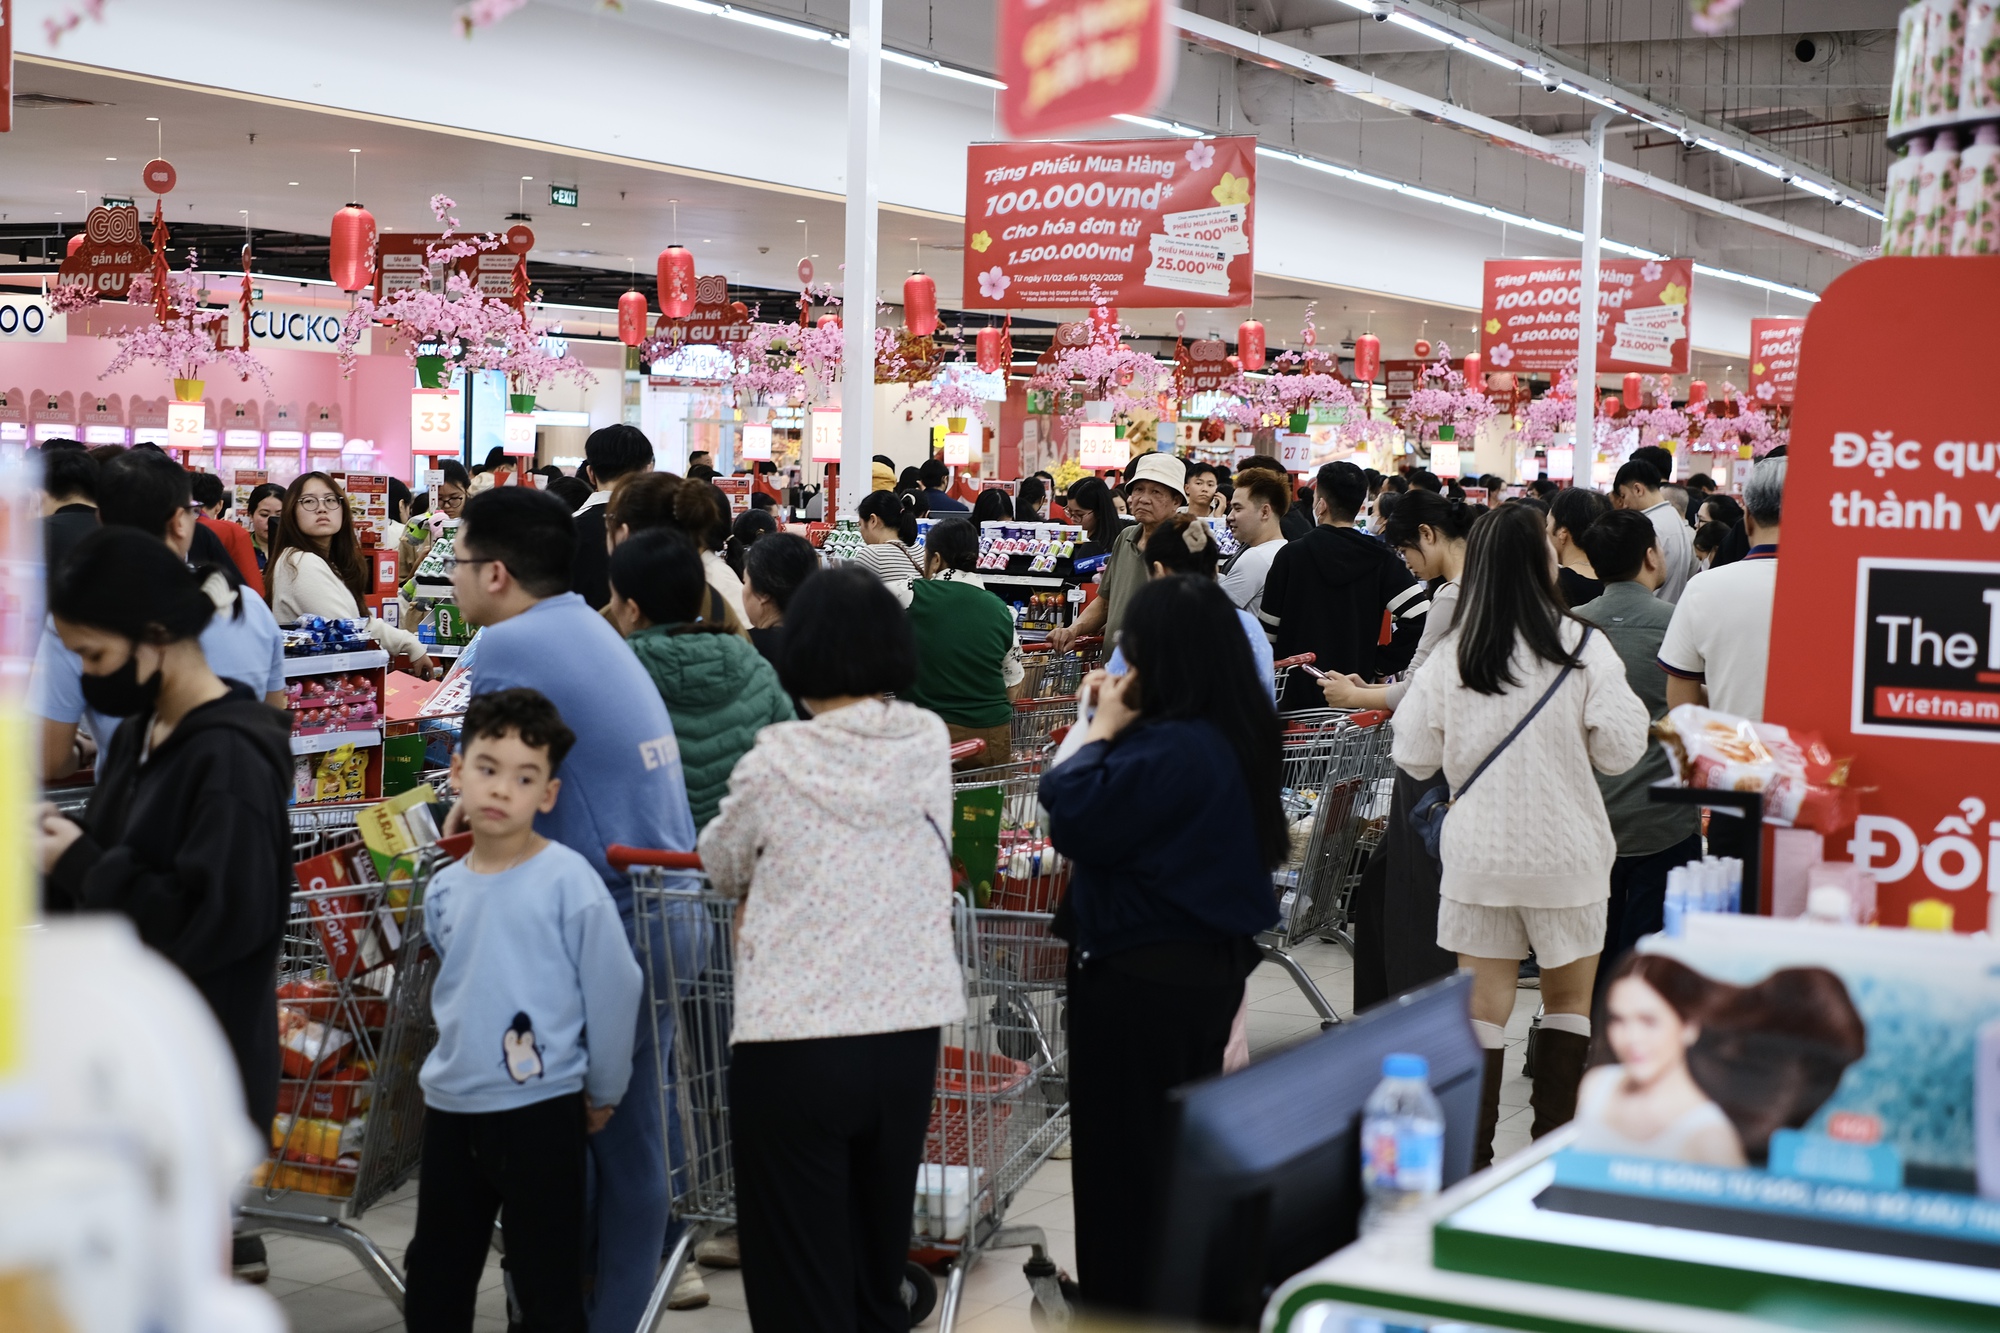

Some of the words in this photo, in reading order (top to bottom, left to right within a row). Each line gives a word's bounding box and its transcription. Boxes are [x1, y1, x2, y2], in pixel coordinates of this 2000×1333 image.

[984, 165, 1027, 185] Tặng
[1030, 154, 1081, 176] Phiếu
[1084, 156, 1123, 172] Mua
[1126, 154, 1176, 179] Hàng
[558, 190, 576, 205] EXIT
[87, 209, 138, 244] GO!
[1002, 223, 1038, 241] Cho
[1041, 218, 1076, 236] hóa
[1079, 217, 1116, 235] đơn
[1120, 217, 1141, 237] từ
[1173, 220, 1192, 230] PHIẾU
[1193, 219, 1208, 227] MUA
[1209, 216, 1228, 225] HÀNG
[91, 251, 112, 266] gắn
[115, 251, 132, 264] kết
[1008, 242, 1135, 265] 1.500.000vnd
[1158, 245, 1177, 254] PHIẾU
[1179, 248, 1194, 256] MUA
[1195, 249, 1215, 259] HÀNG
[1156, 256, 1205, 274] 25.000
[98, 273, 125, 291] GU
[1043, 273, 1062, 282] 11/02
[1063, 273, 1078, 282] đến
[1079, 273, 1124, 282] 16/02/2026
[1495, 274, 1527, 289] Tặng
[1528, 267, 1566, 283] Phiếu
[1600, 269, 1634, 286] Hàng
[705, 309, 721, 320] kết
[1508, 314, 1534, 326] Cho
[1536, 311, 1562, 324] hóa
[690, 326, 715, 340] GU
[718, 319, 751, 340] TẾT
[1620, 339, 1655, 351] 25.000
[1197, 377, 1217, 387] GU
[35, 411, 70, 421] WELCOME
[85, 414, 119, 423] WELCOME
[420, 412, 451, 433] 33
[173, 418, 199, 434] 32
[509, 428, 531, 442] 30
[815, 427, 828, 443] 31
[949, 444, 965, 455] 26
[1083, 439, 1097, 454] 29
[1102, 439, 1113, 454] 29
[1284, 447, 1296, 459] 27
[1301, 447, 1309, 460] 27
[1830, 430, 1922, 478] Đặc
[1829, 489, 1962, 531] thành
[1875, 615, 1978, 669] The
[1887, 692, 2000, 719] Vietnam
[374, 808, 396, 841] HURA
